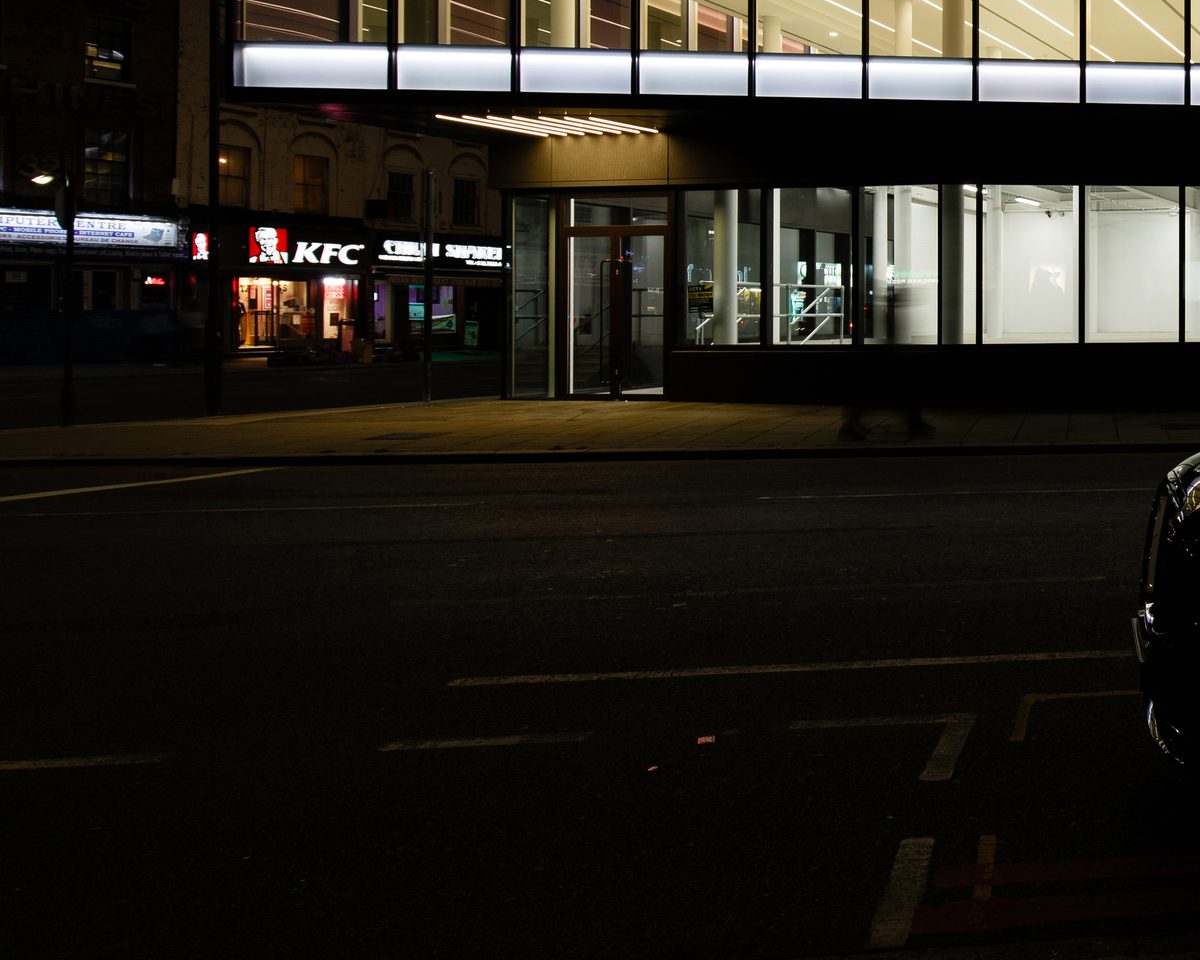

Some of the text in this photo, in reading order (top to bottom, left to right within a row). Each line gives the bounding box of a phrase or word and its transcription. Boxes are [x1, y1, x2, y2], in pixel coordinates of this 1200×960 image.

[0, 215, 127, 230] PUTER ENTRE
[292, 242, 364, 265] KFC
